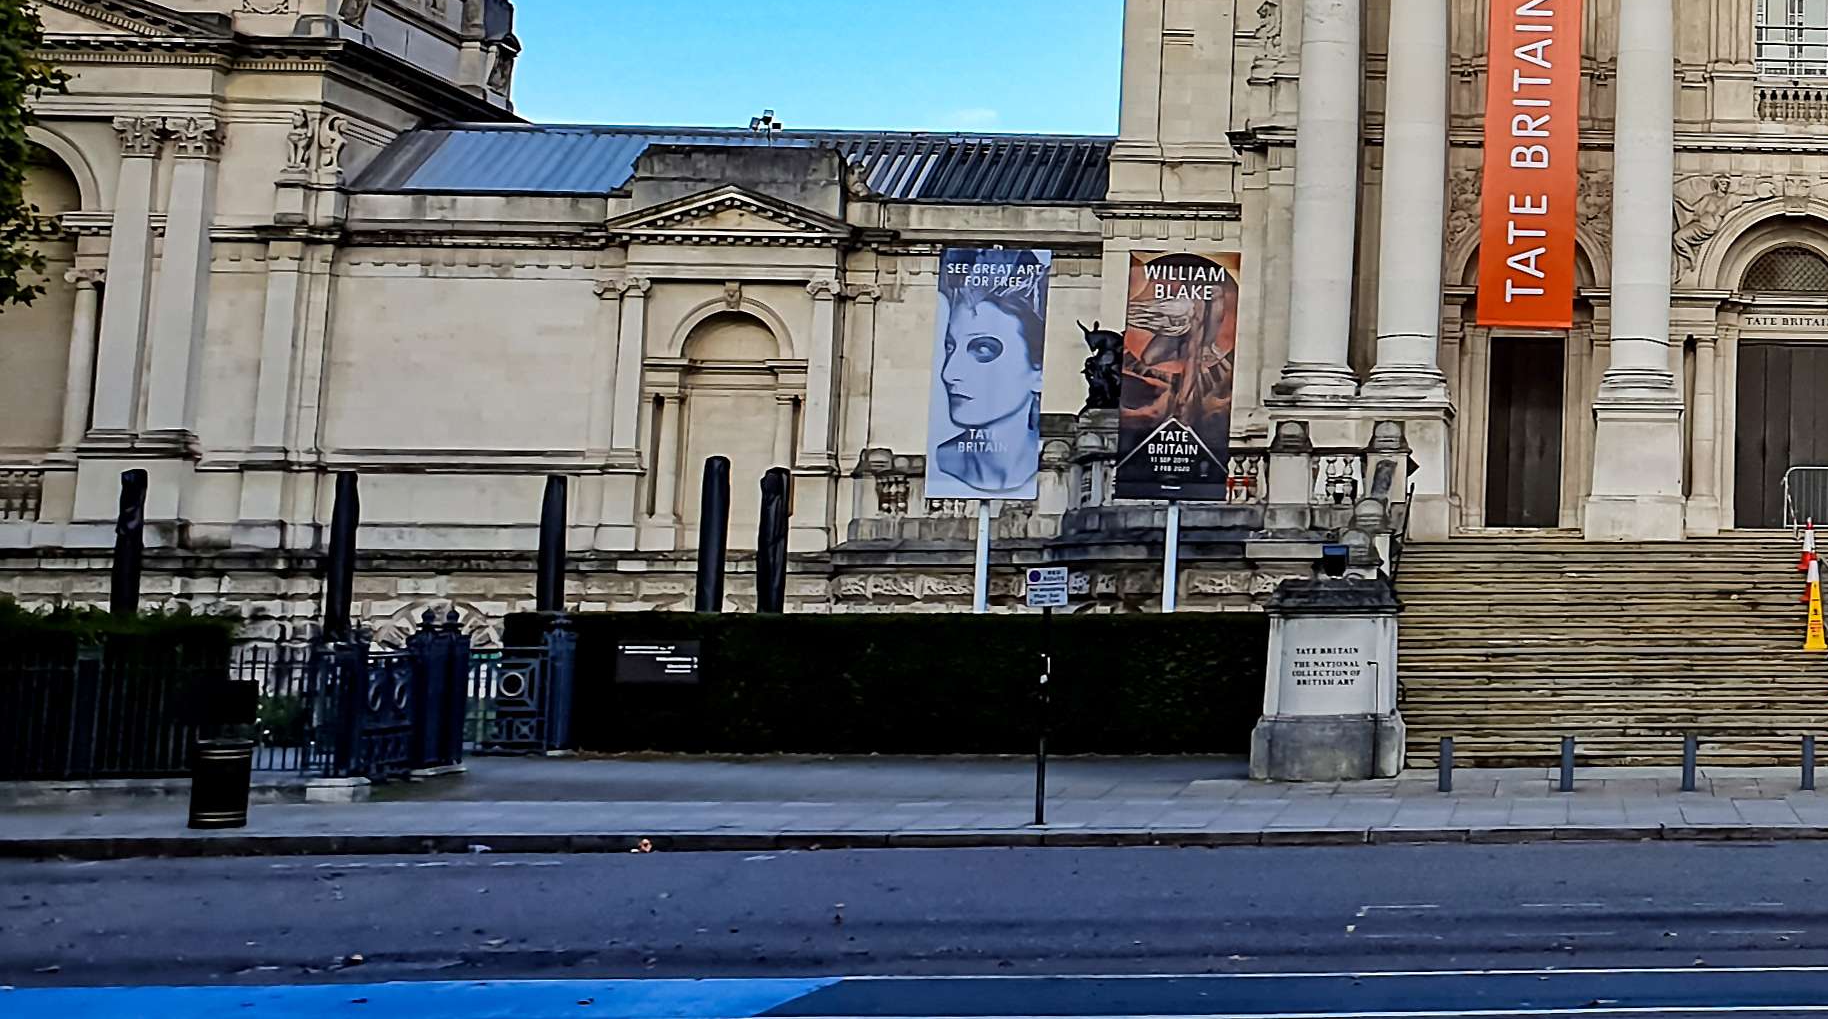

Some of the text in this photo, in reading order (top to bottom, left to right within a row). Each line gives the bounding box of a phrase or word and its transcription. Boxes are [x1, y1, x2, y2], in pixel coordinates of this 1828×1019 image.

[1505, 194, 1548, 303] TATE
[946, 262, 1043, 275] SEE GREAT ART
[1144, 264, 1225, 282] WILLIAM
[964, 275, 1023, 287] FOR FREE
[1154, 283, 1214, 300] BLAKE
[1745, 317, 1777, 325] TATE
[969, 428, 996, 440] TAT
[1160, 430, 1189, 442] TATE
[1147, 443, 1199, 455] BRITAIN
[1319, 647, 1359, 655] BRITAIN
